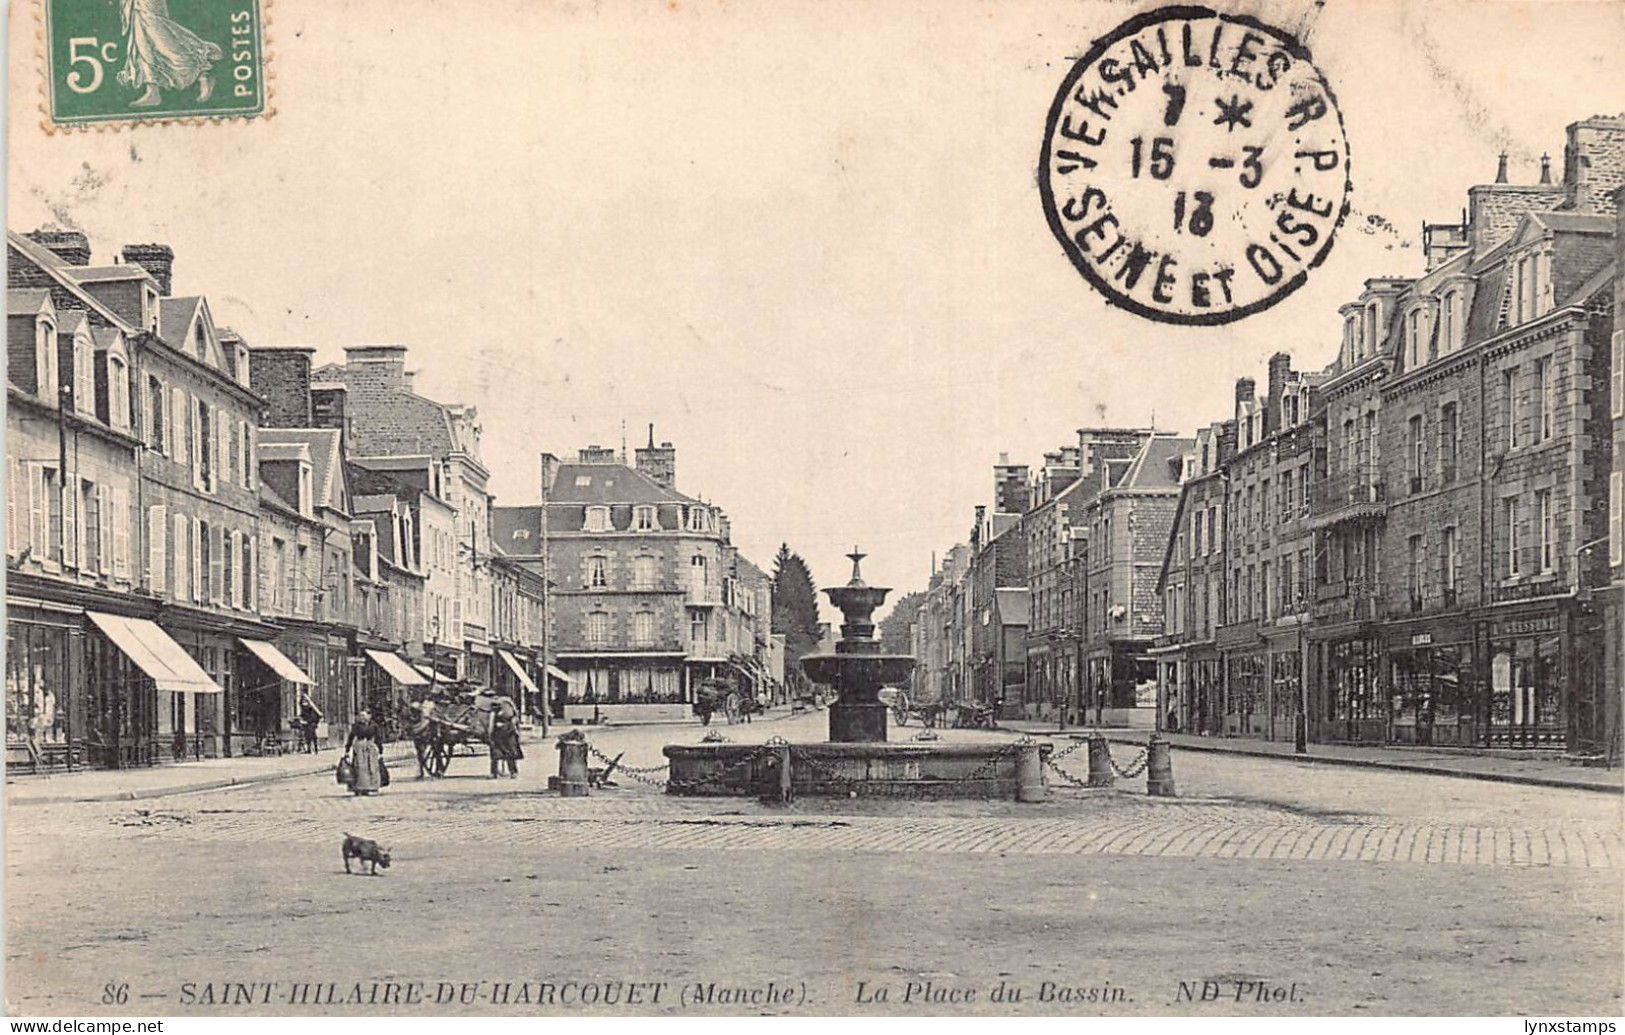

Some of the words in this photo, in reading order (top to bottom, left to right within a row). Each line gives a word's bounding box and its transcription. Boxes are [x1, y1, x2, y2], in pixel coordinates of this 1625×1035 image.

[231, 10, 253, 98] POSTES
[1055, 22, 1292, 176] VERSAILLES
[1129, 136, 1175, 182] 15
[1062, 186, 1178, 306] SEINE
[1190, 264, 1236, 309] ET
[1245, 186, 1334, 287] OISE
